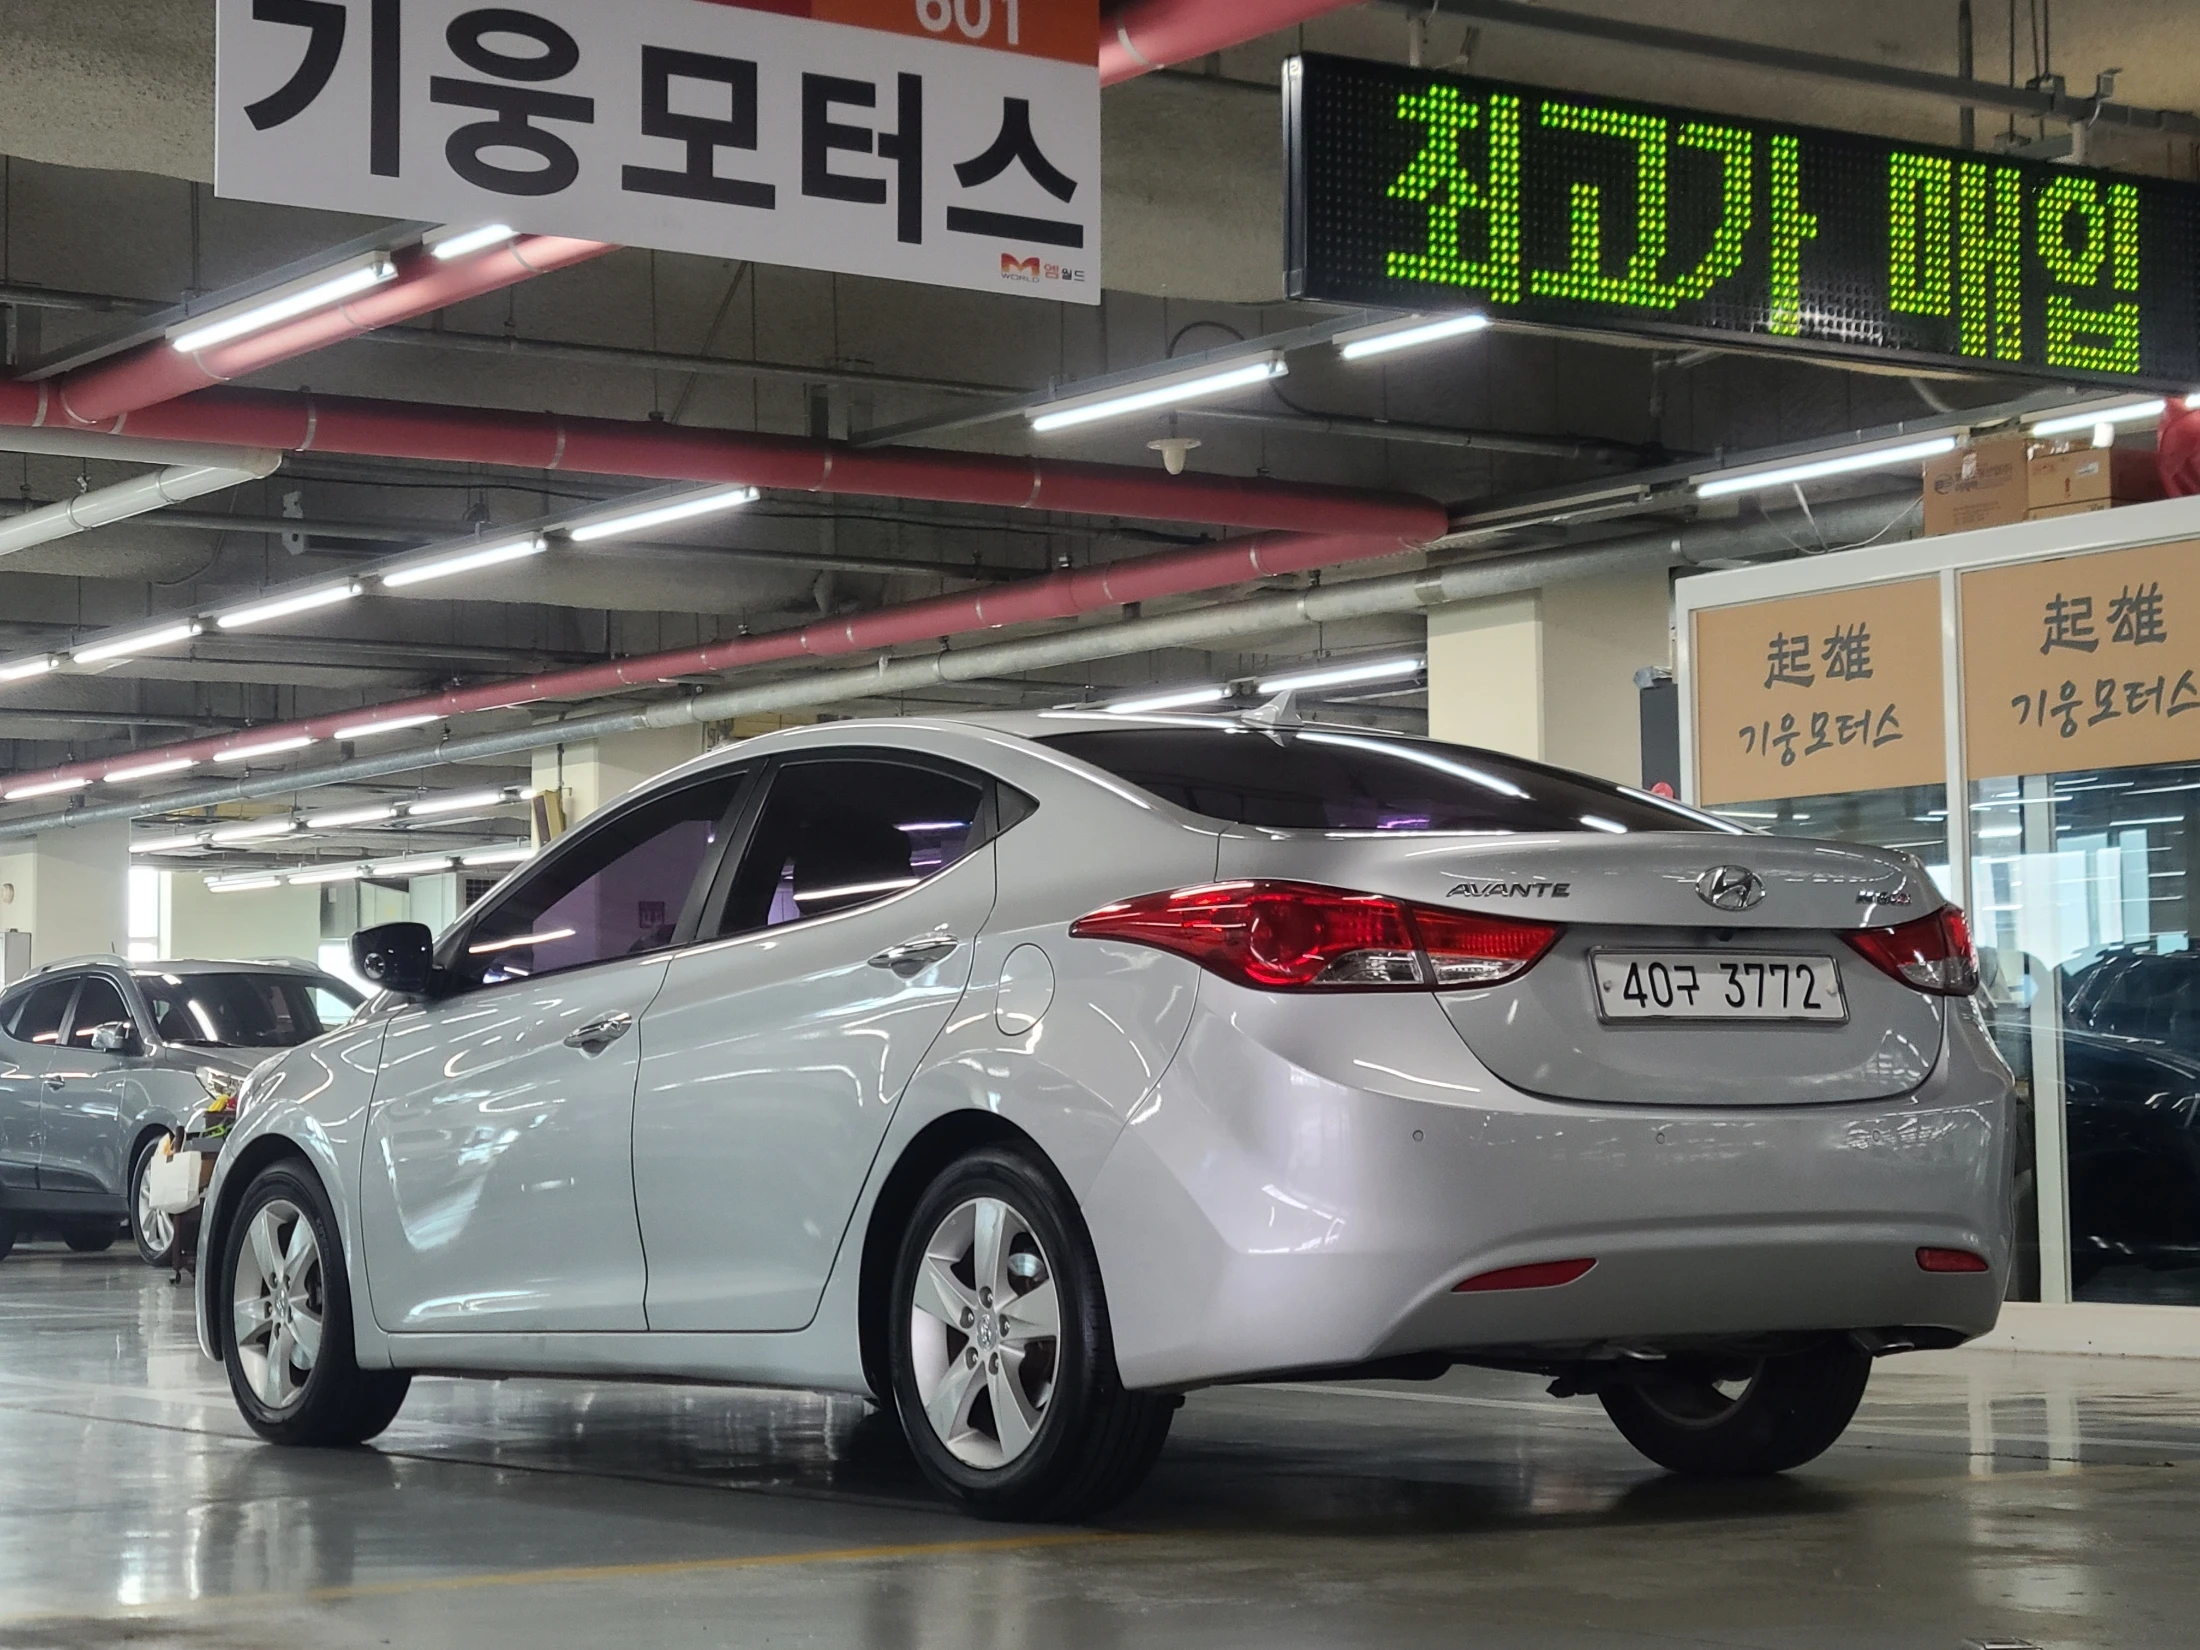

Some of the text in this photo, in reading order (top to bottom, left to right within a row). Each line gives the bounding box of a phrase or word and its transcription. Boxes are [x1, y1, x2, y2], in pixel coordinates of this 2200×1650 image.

[243, 0, 1084, 249] 기웅모터스
[1386, 85, 2140, 374] 최고가 매입
[1001, 272, 1040, 283] WORLD
[1044, 263, 1085, 282] 엠월드
[2040, 581, 2168, 656] 起雄
[1763, 622, 1874, 690] 起雄
[1738, 703, 1904, 767] 기웅모터스
[2011, 669, 2200, 740] 기웅모터스
[1445, 882, 1571, 898] AVANTE
[1623, 961, 1822, 1009] 40구 3772
